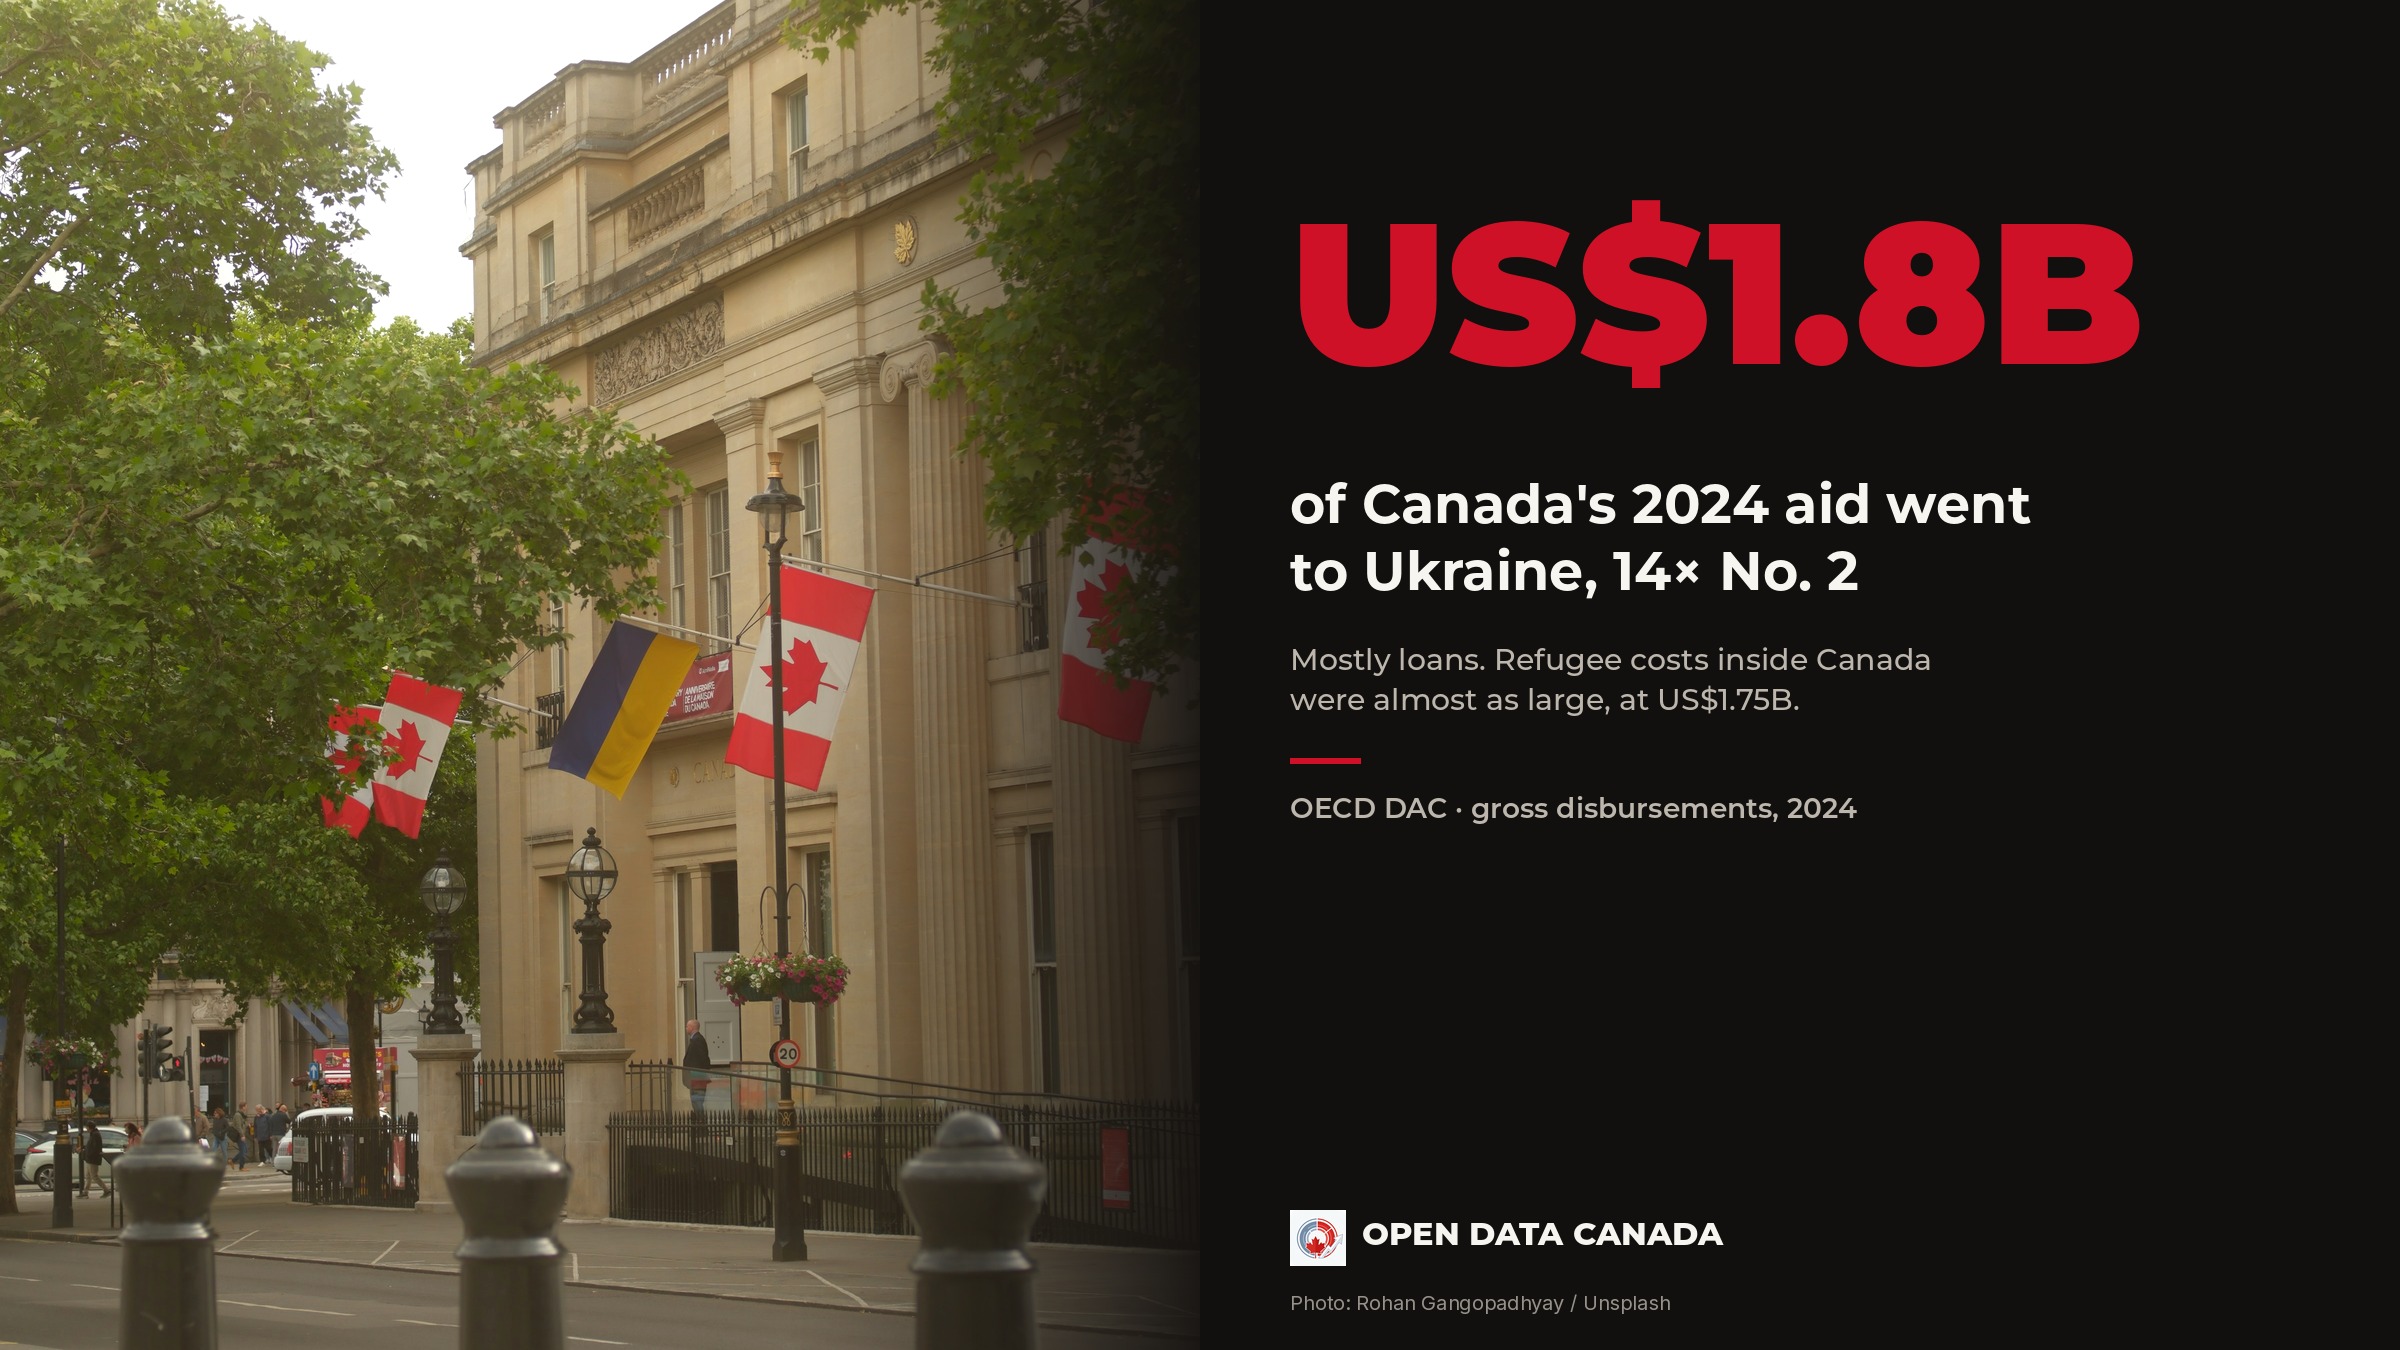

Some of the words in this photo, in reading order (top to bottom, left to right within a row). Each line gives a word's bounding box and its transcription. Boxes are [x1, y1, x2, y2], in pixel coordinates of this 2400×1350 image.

[685, 695, 690, 704] DE
[685, 704, 690, 713] DU
[780, 1048, 797, 1059] 20
